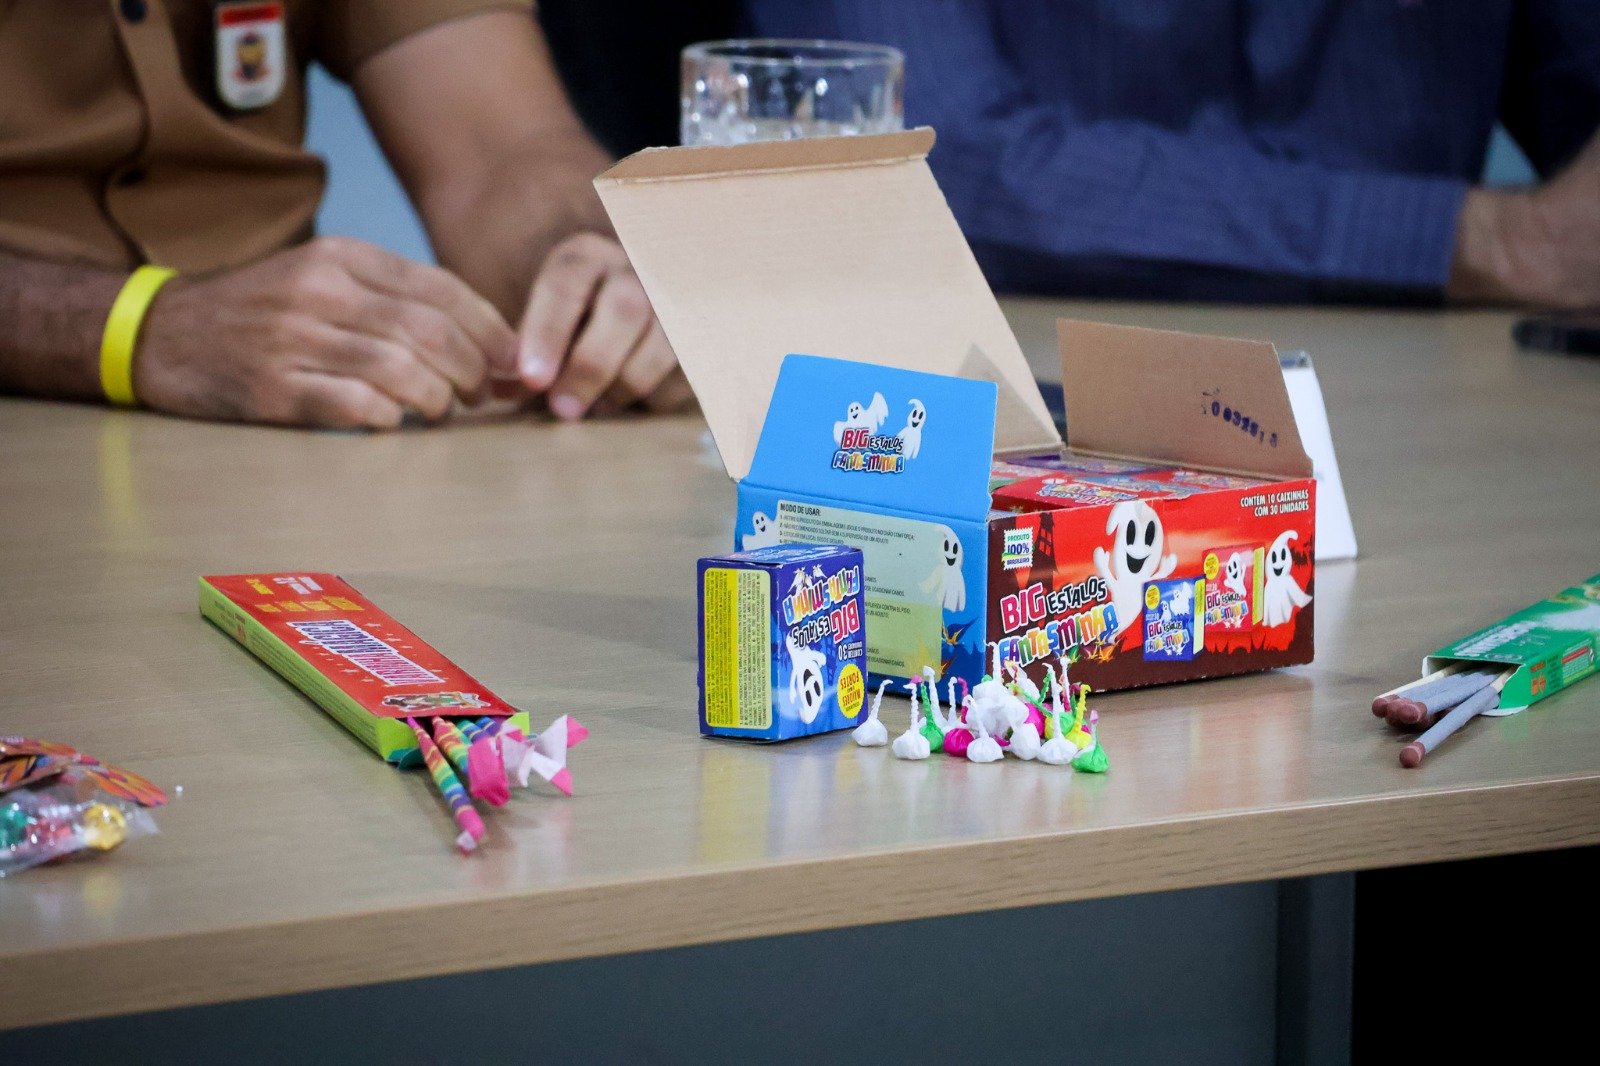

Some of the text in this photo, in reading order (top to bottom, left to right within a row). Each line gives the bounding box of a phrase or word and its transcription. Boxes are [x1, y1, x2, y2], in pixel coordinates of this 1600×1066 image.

[842, 428, 904, 453] BIG ESTALOS
[832, 451, 905, 473] FANTASMINHA
[1267, 494, 1276, 504] 10
[1276, 489, 1309, 502] CAIXINHAS
[780, 503, 797, 513] MODO
[797, 505, 805, 514] DE
[1254, 500, 1309, 517] COM 30 UNIDADES
[1007, 533, 1030, 541] PRODUTO
[1007, 542, 1030, 555] 100%
[782, 565, 860, 627] FANTASMINHA
[1001, 582, 1047, 633] BIG
[1046, 576, 1108, 614] ESTALOS
[1206, 590, 1221, 611] BIG
[792, 598, 860, 650] BIG ESTALOS
[1148, 620, 1163, 638] BIG
[998, 602, 1119, 667] FANTASMINHA
[838, 644, 848, 661] 30
[840, 671, 860, 690] FORTES
